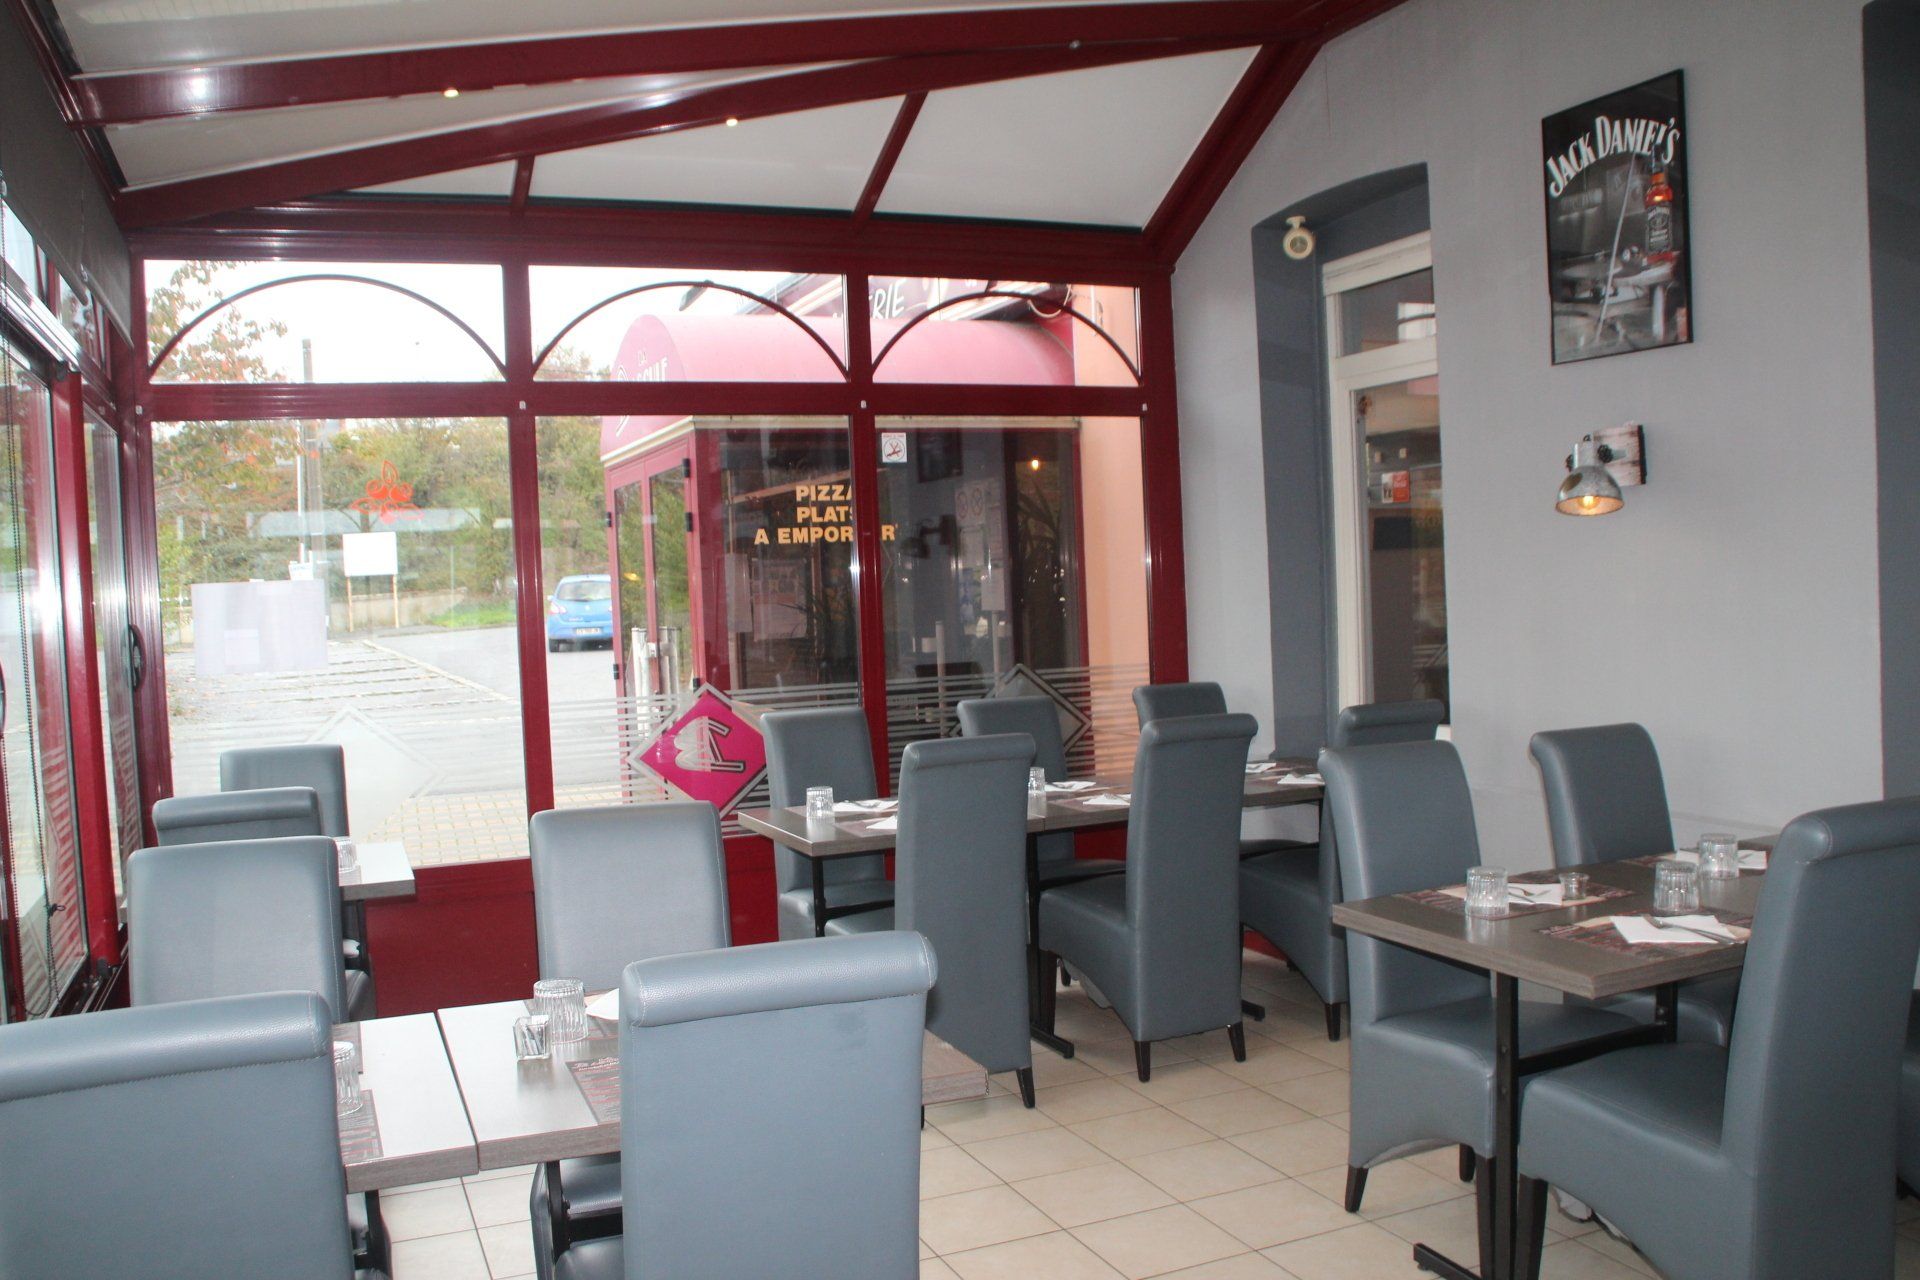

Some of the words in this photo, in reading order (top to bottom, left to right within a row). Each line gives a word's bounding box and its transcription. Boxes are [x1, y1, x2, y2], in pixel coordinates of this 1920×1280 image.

[1546, 132, 1597, 198] JACK
[796, 506, 853, 523] PLAT
[754, 528, 770, 545] A
[777, 524, 896, 545] EMPORR
